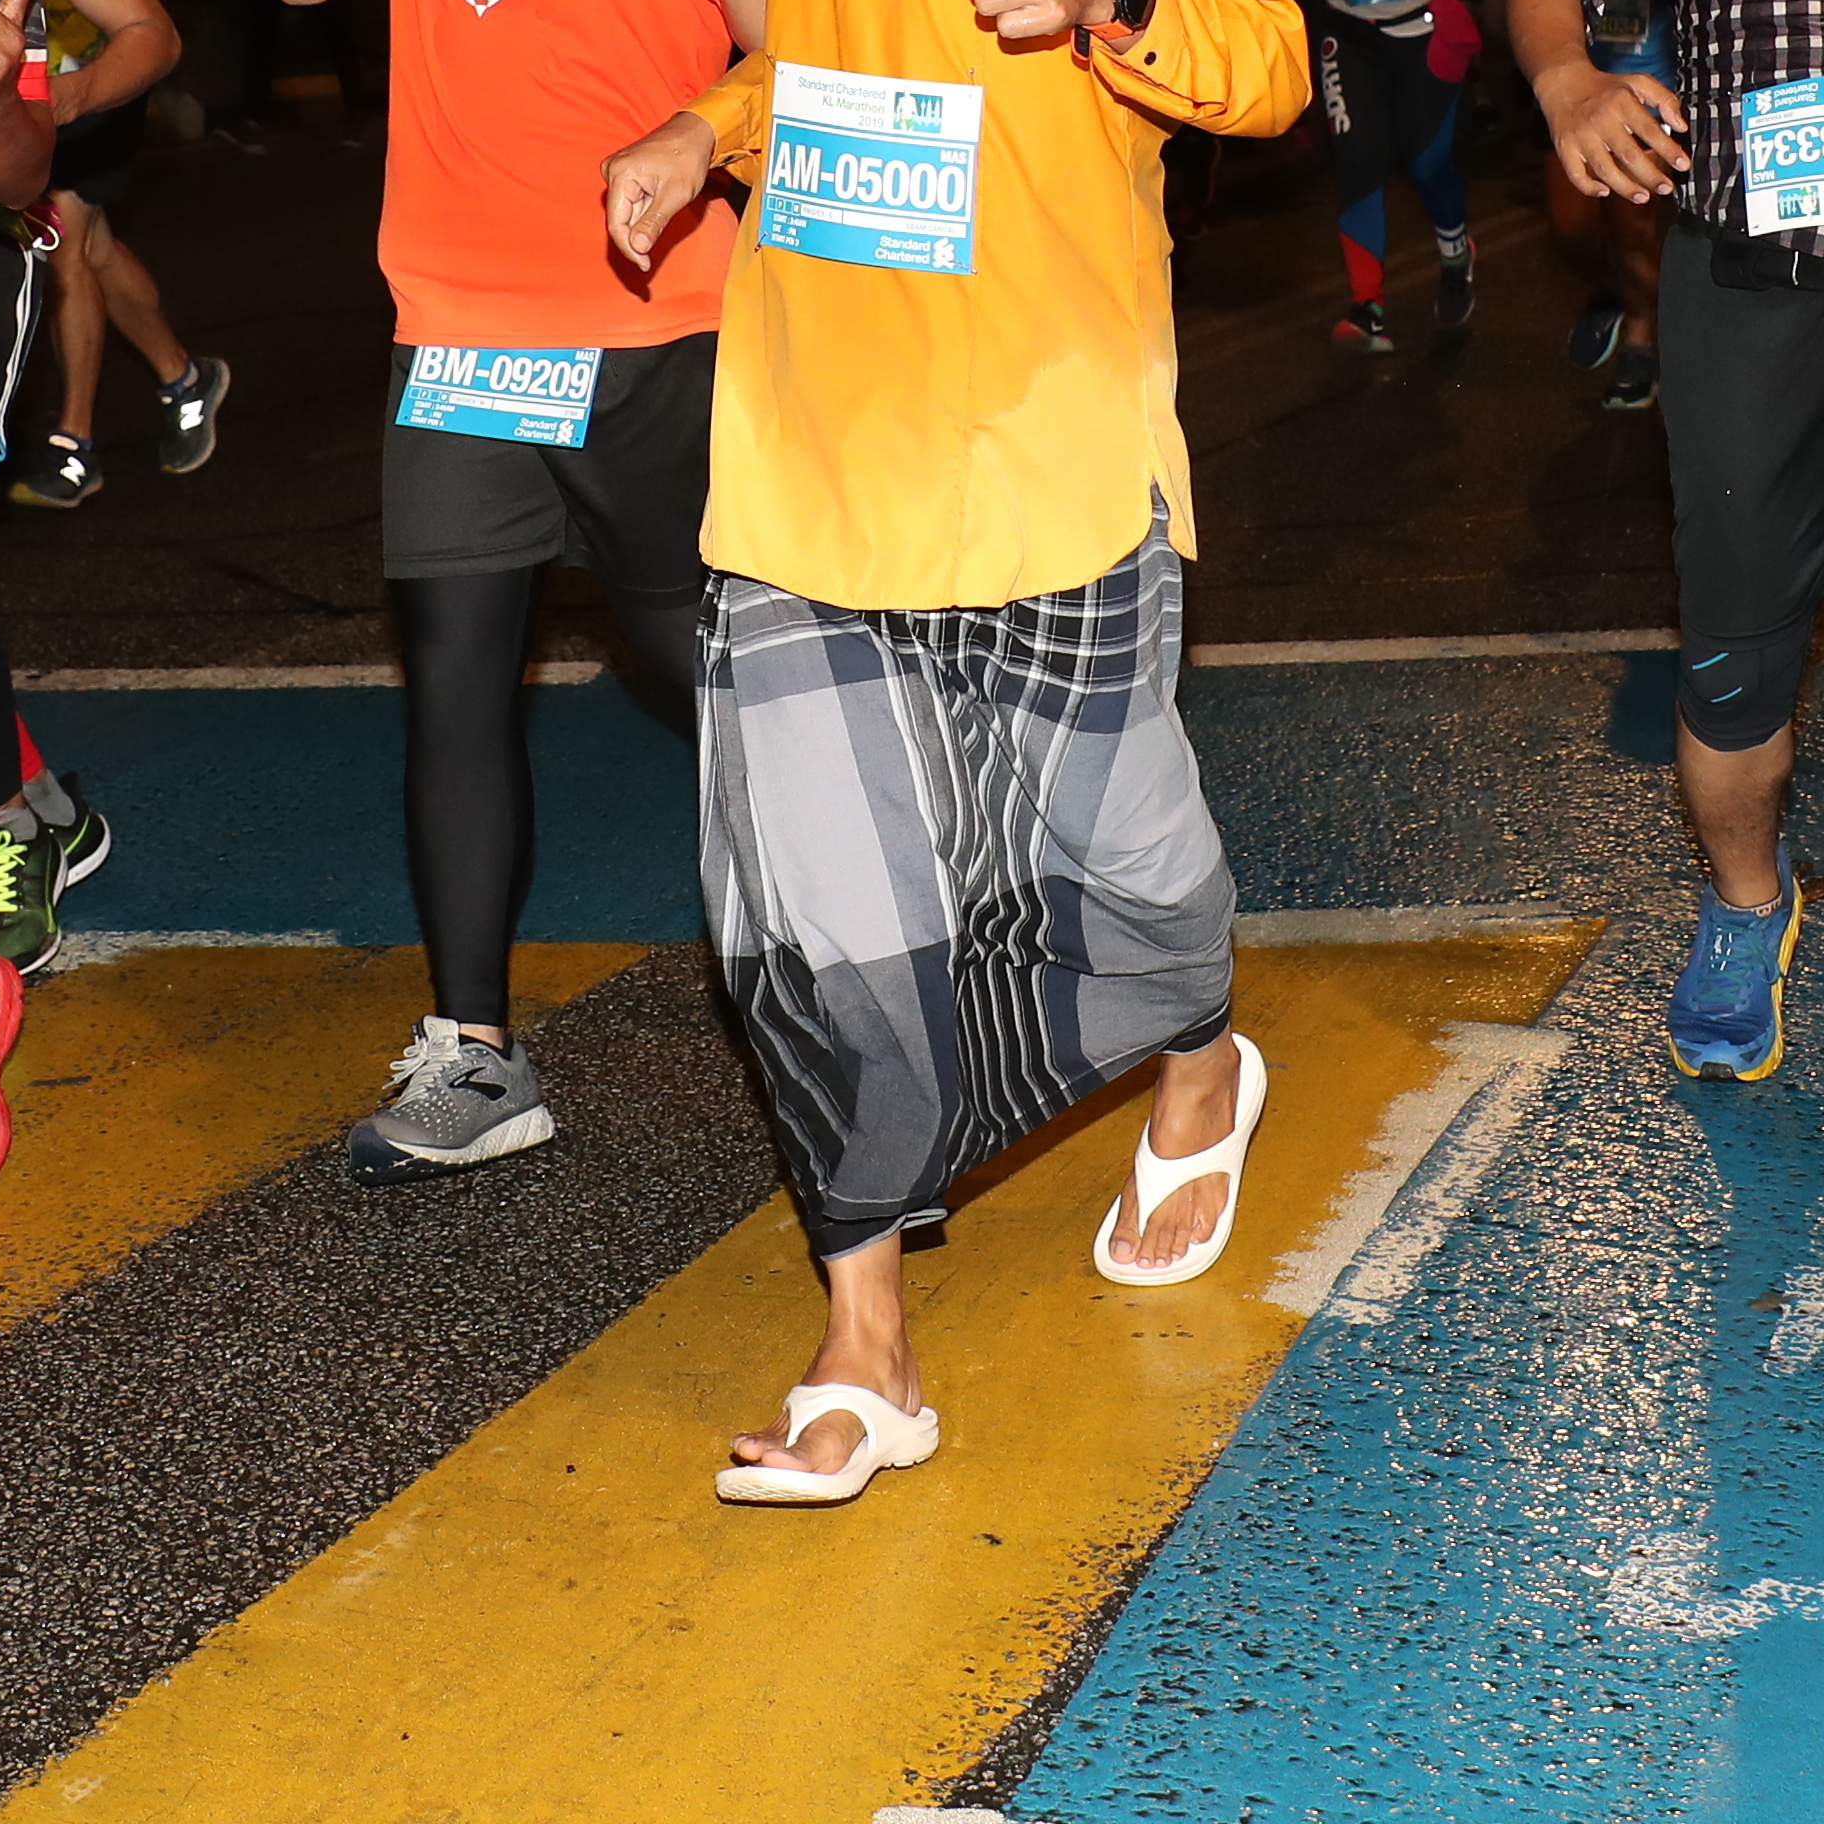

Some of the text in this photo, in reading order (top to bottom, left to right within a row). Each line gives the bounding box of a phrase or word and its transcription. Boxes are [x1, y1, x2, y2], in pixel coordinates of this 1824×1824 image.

[798, 76, 886, 100] Standard Chartered
[1774, 82, 1819, 97] Chartered
[822, 95, 884, 114] KL Marathon
[1774, 93, 1816, 108] Standard
[858, 115, 884, 128] 2019
[940, 150, 967, 164] MAS
[772, 141, 965, 212] AM-05000
[1753, 170, 1775, 182] MAS
[880, 234, 930, 252] Standard
[874, 248, 930, 264] Chartered
[574, 350, 596, 362] MAS
[418, 346, 591, 400] BM-09209
[519, 418, 558, 431] Standard
[514, 428, 555, 441] Chartered
